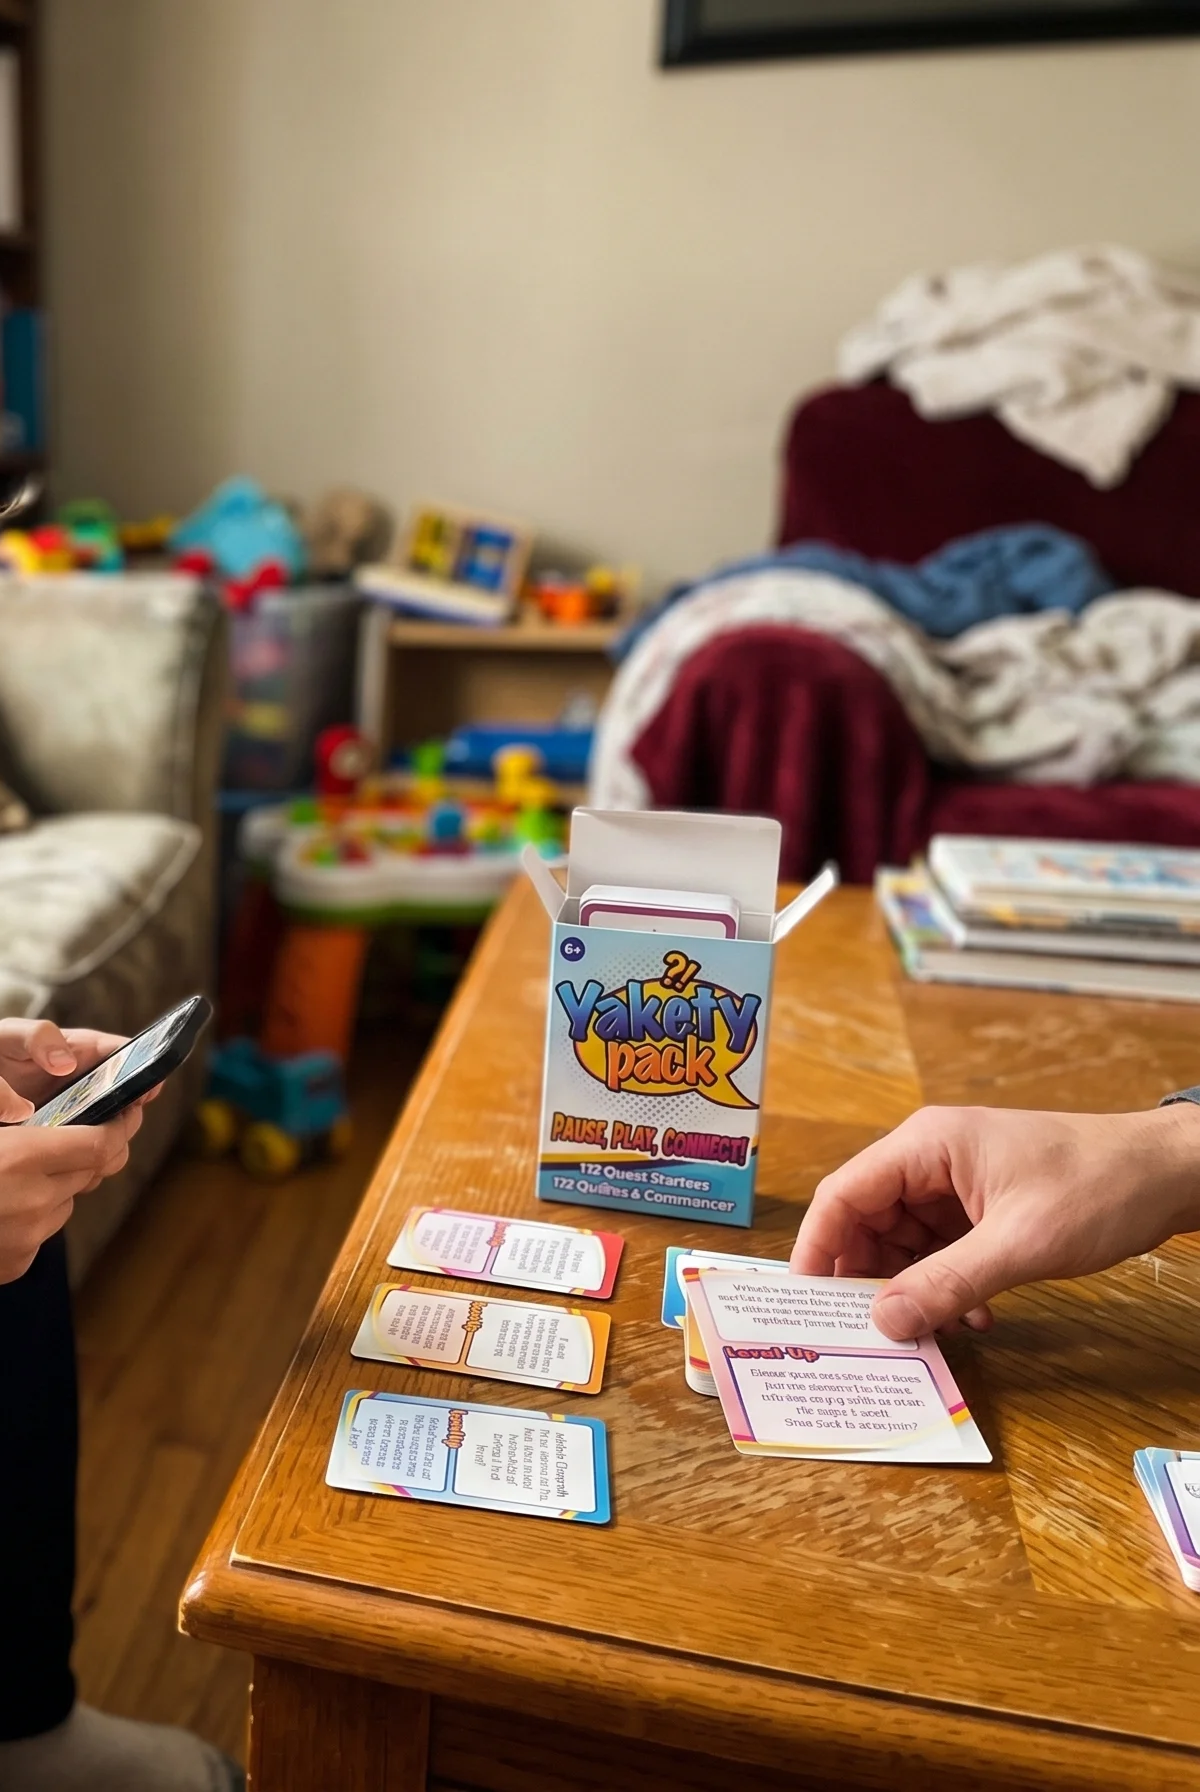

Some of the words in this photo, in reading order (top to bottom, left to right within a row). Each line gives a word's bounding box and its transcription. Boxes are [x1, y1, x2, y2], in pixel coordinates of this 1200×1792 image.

[564, 943, 581, 955] 6+
[556, 979, 762, 1053] Yakety
[606, 1034, 717, 1092] pack
[551, 1112, 607, 1150] PAUSE,
[610, 1120, 658, 1156] PLAY,
[662, 1127, 750, 1166] CONNECT!
[603, 1166, 648, 1182] Quest
[630, 1189, 641, 1199] &
